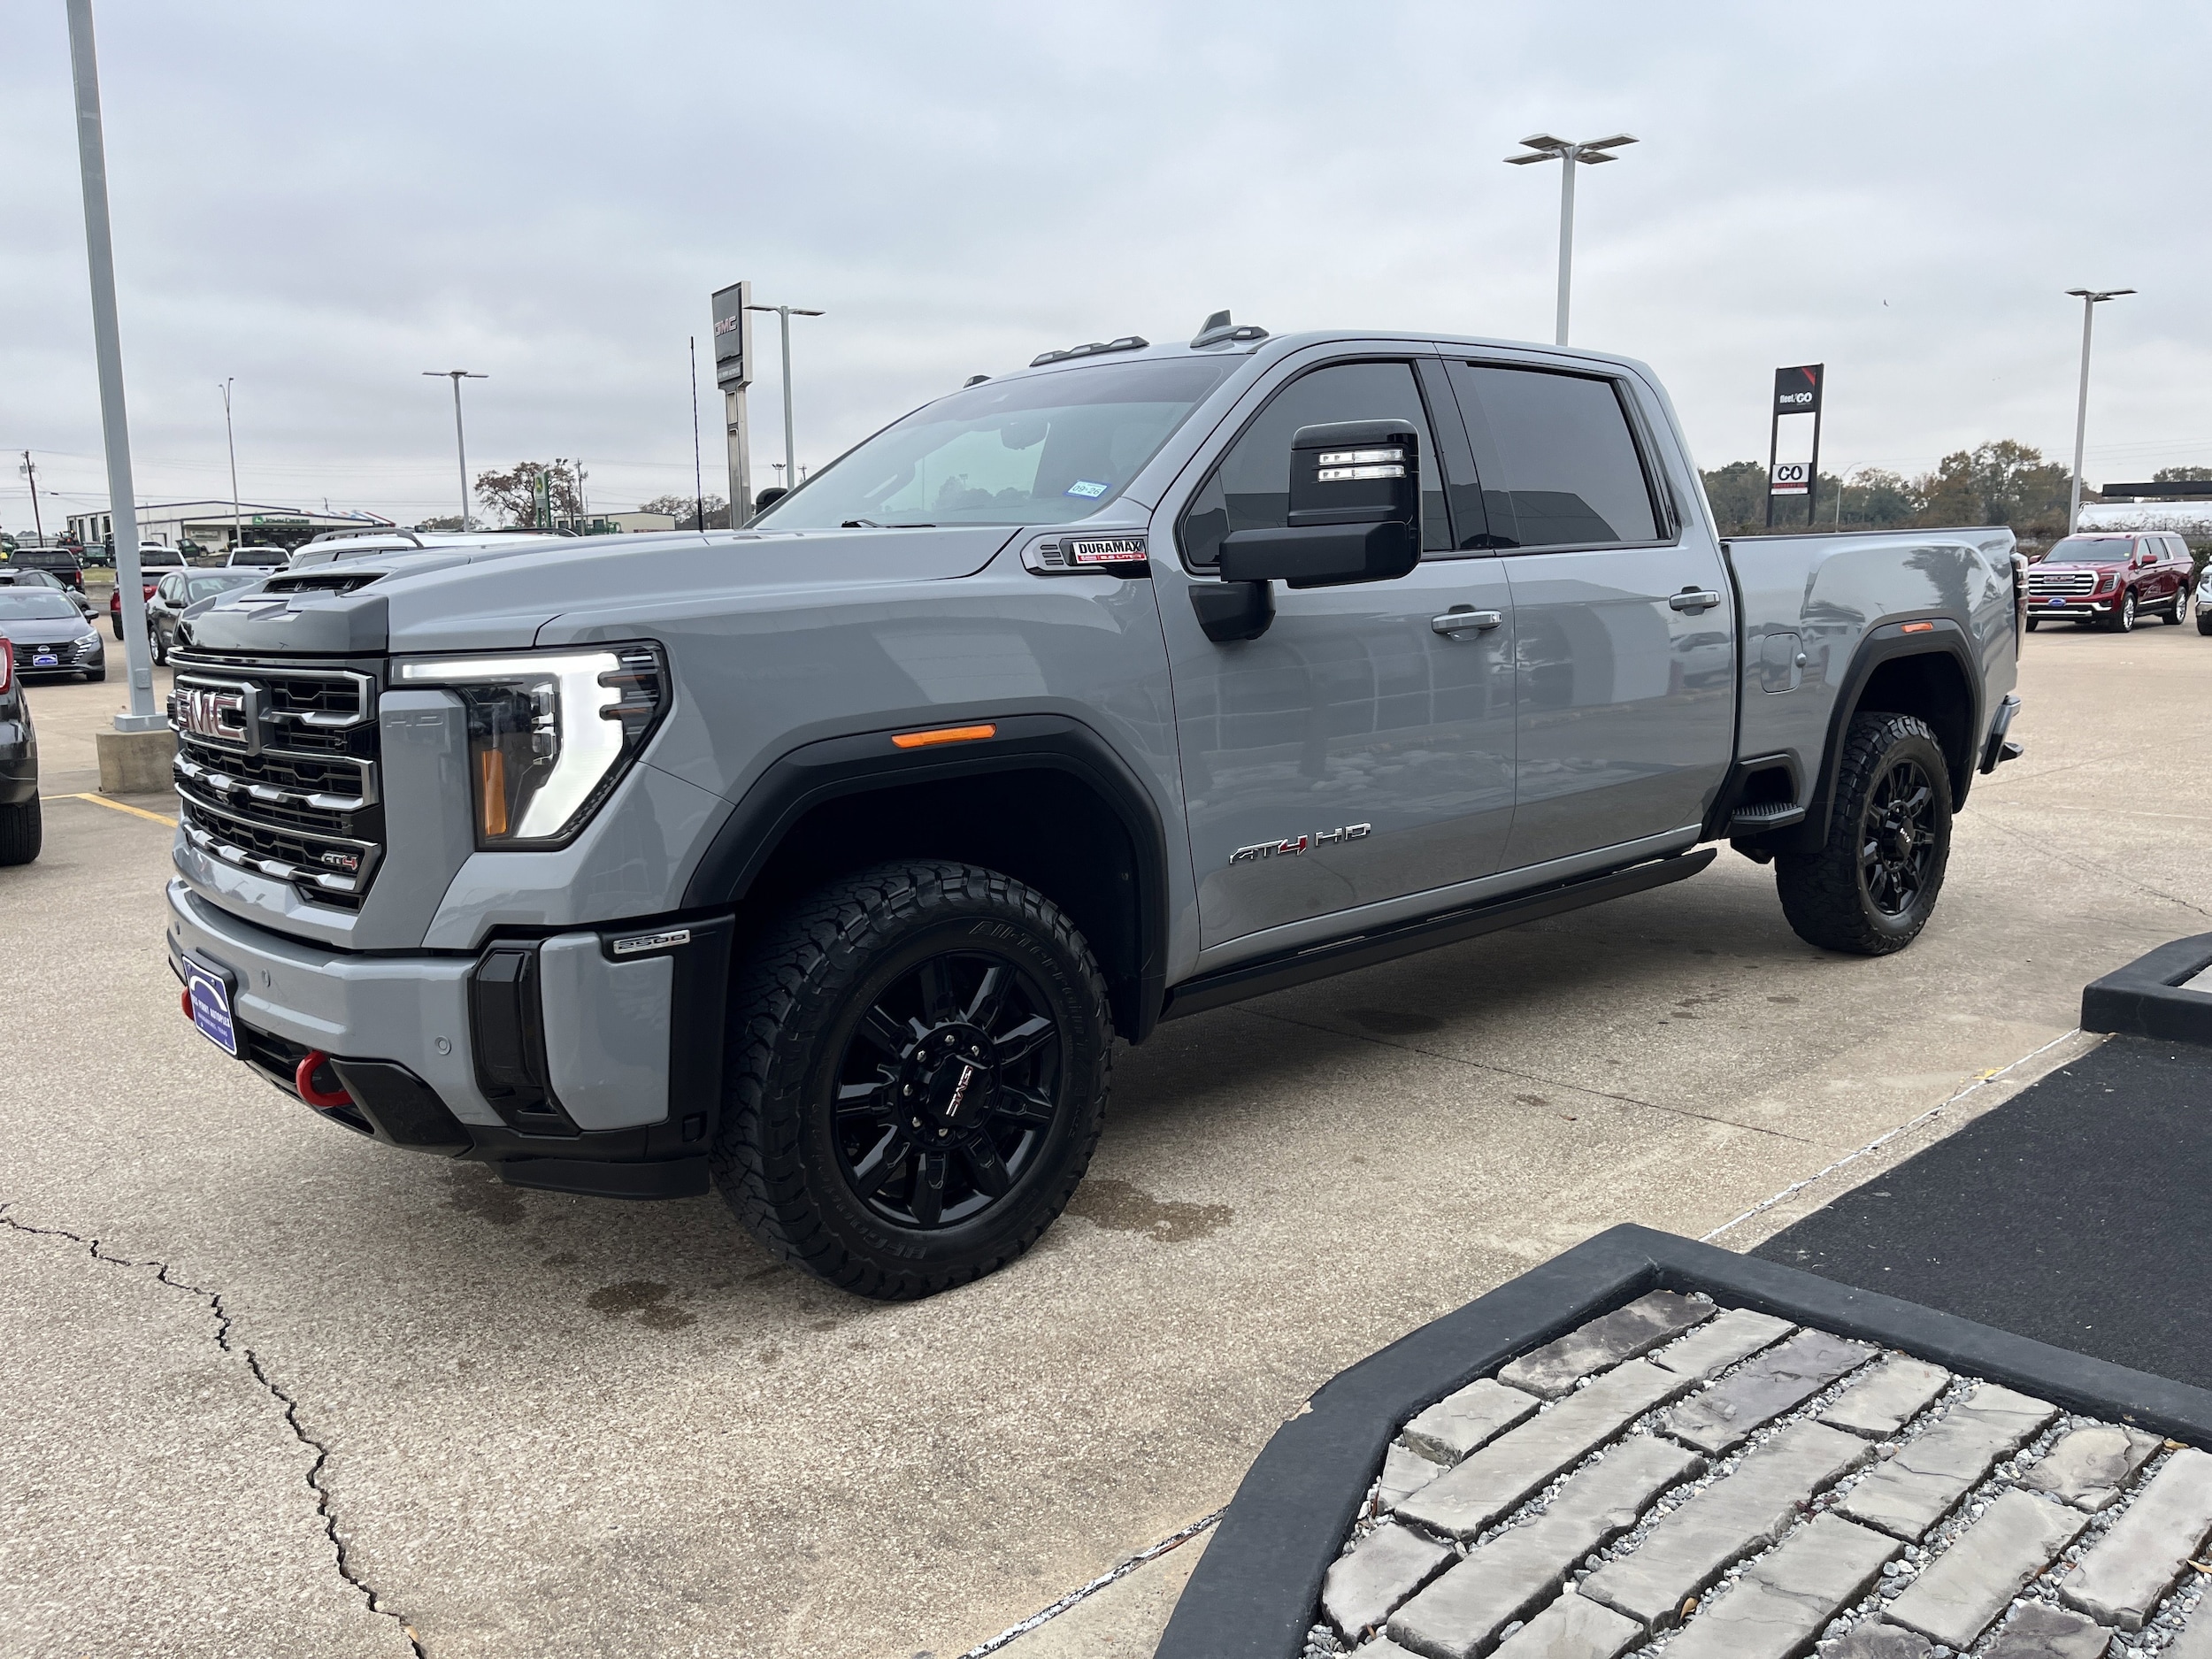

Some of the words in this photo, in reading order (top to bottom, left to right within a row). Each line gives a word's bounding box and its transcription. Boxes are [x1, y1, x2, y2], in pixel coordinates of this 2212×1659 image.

[714, 316, 737, 337] GMC
[1079, 541, 1141, 554] DURAMAX
[176, 687, 248, 742] GMC
[1228, 833, 1309, 864] AT4
[1315, 822, 1371, 847] HD
[321, 852, 358, 871] AT4
[618, 933, 687, 950] 2500
[945, 1064, 975, 1118] GMC
